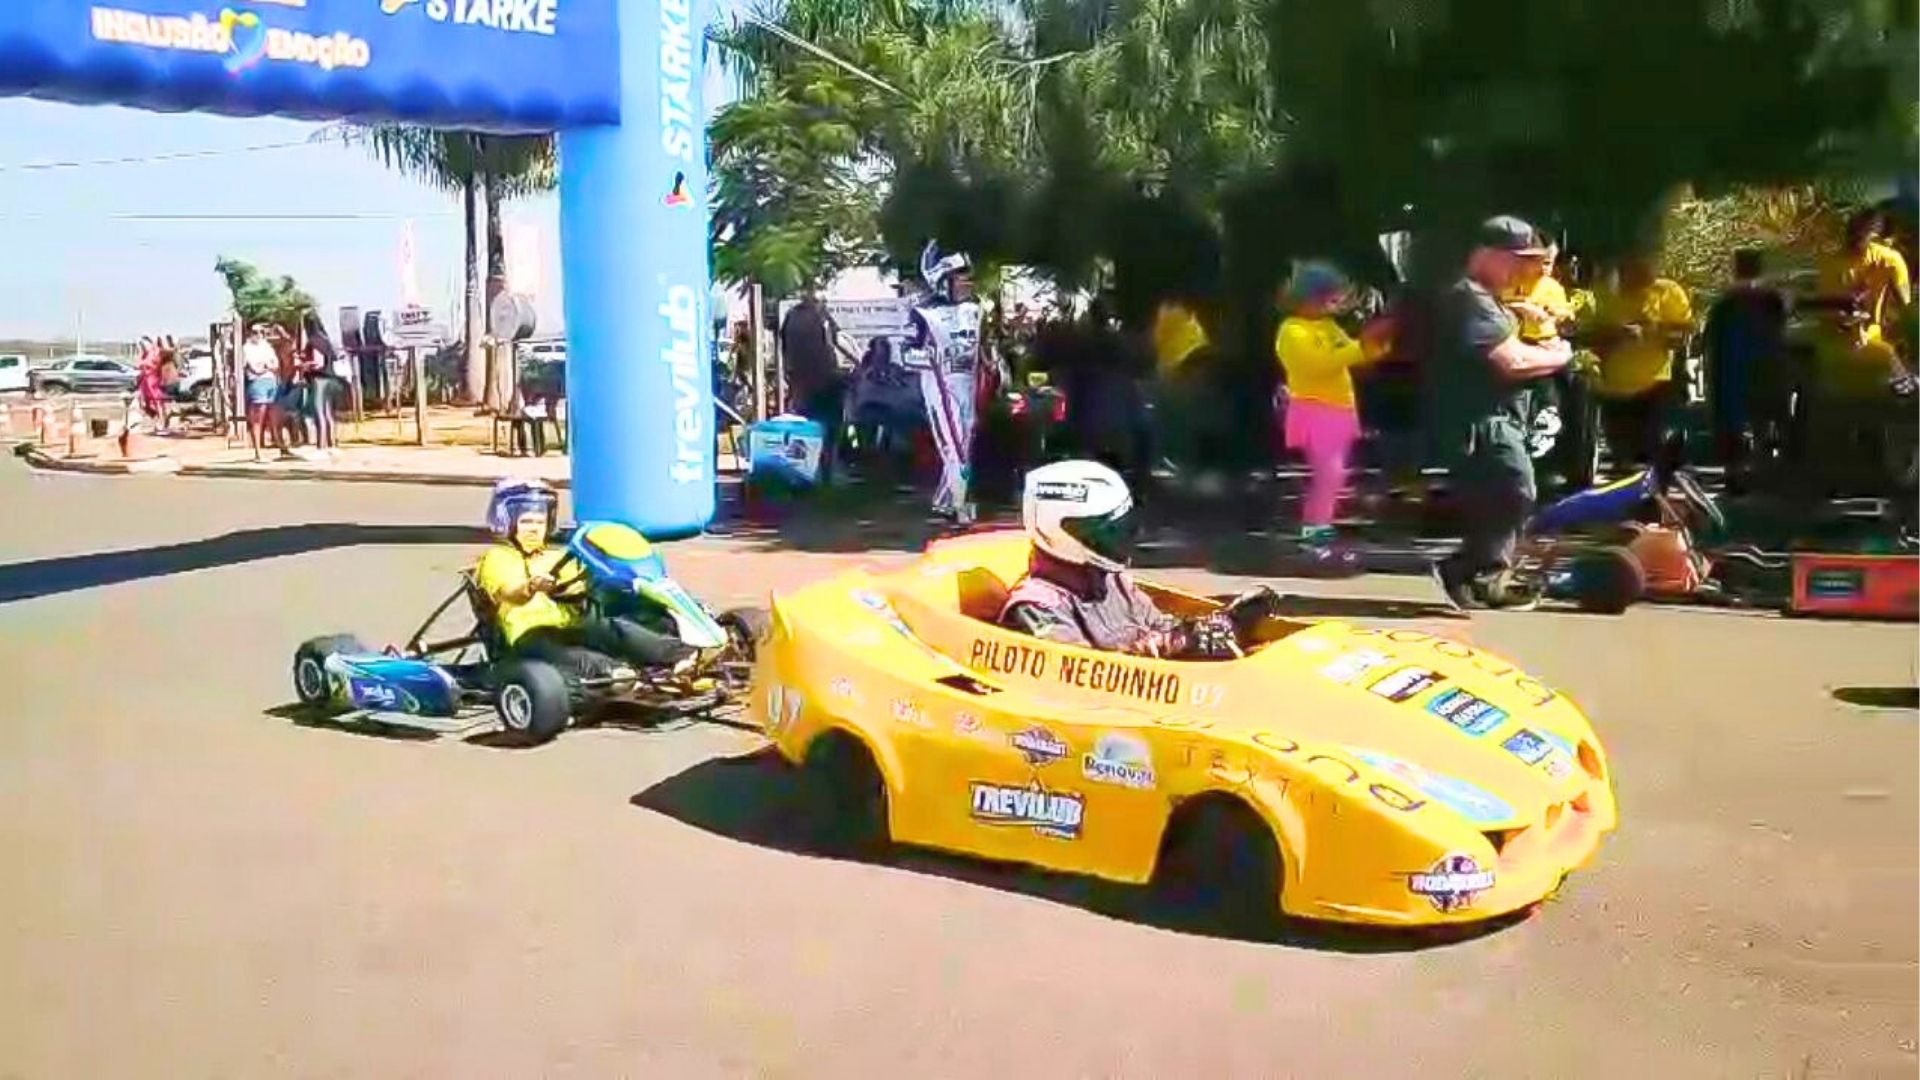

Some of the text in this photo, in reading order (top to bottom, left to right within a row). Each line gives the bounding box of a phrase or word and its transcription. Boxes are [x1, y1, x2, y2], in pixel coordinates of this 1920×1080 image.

[657, 284, 703, 485] trevilub
[971, 639, 1046, 679] PILOTO
[1059, 654, 1180, 705] NEGUINHO
